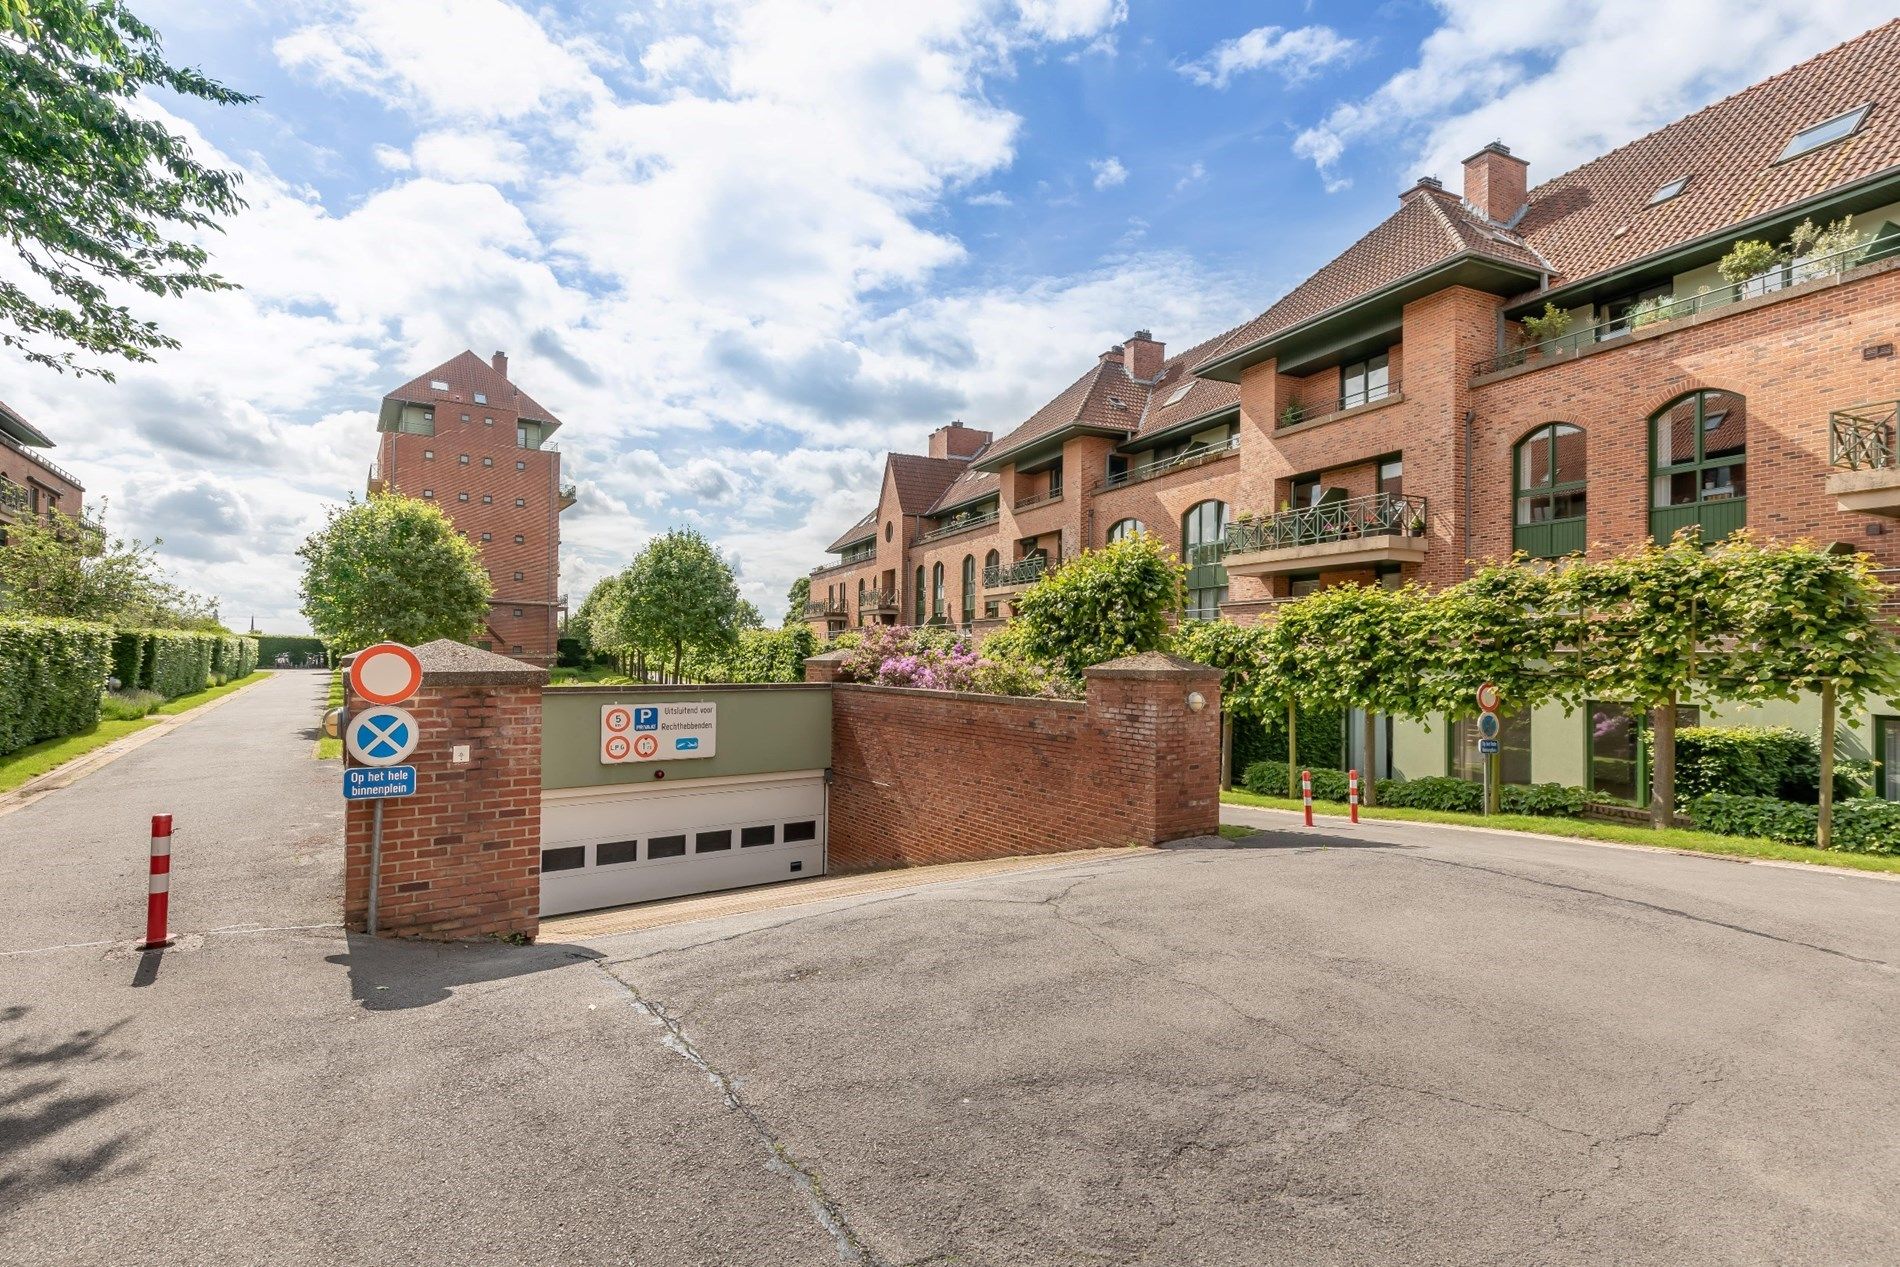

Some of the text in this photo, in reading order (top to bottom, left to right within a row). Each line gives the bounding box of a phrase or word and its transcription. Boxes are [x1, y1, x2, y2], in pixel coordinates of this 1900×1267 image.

[640, 709, 652, 723] P
[664, 706, 698, 715] Uitsluitend
[615, 715, 622, 723] 5
[661, 721, 713, 731] Rechthebbenden
[351, 770, 408, 784] Op het hele
[352, 783, 407, 796] binnenplein
